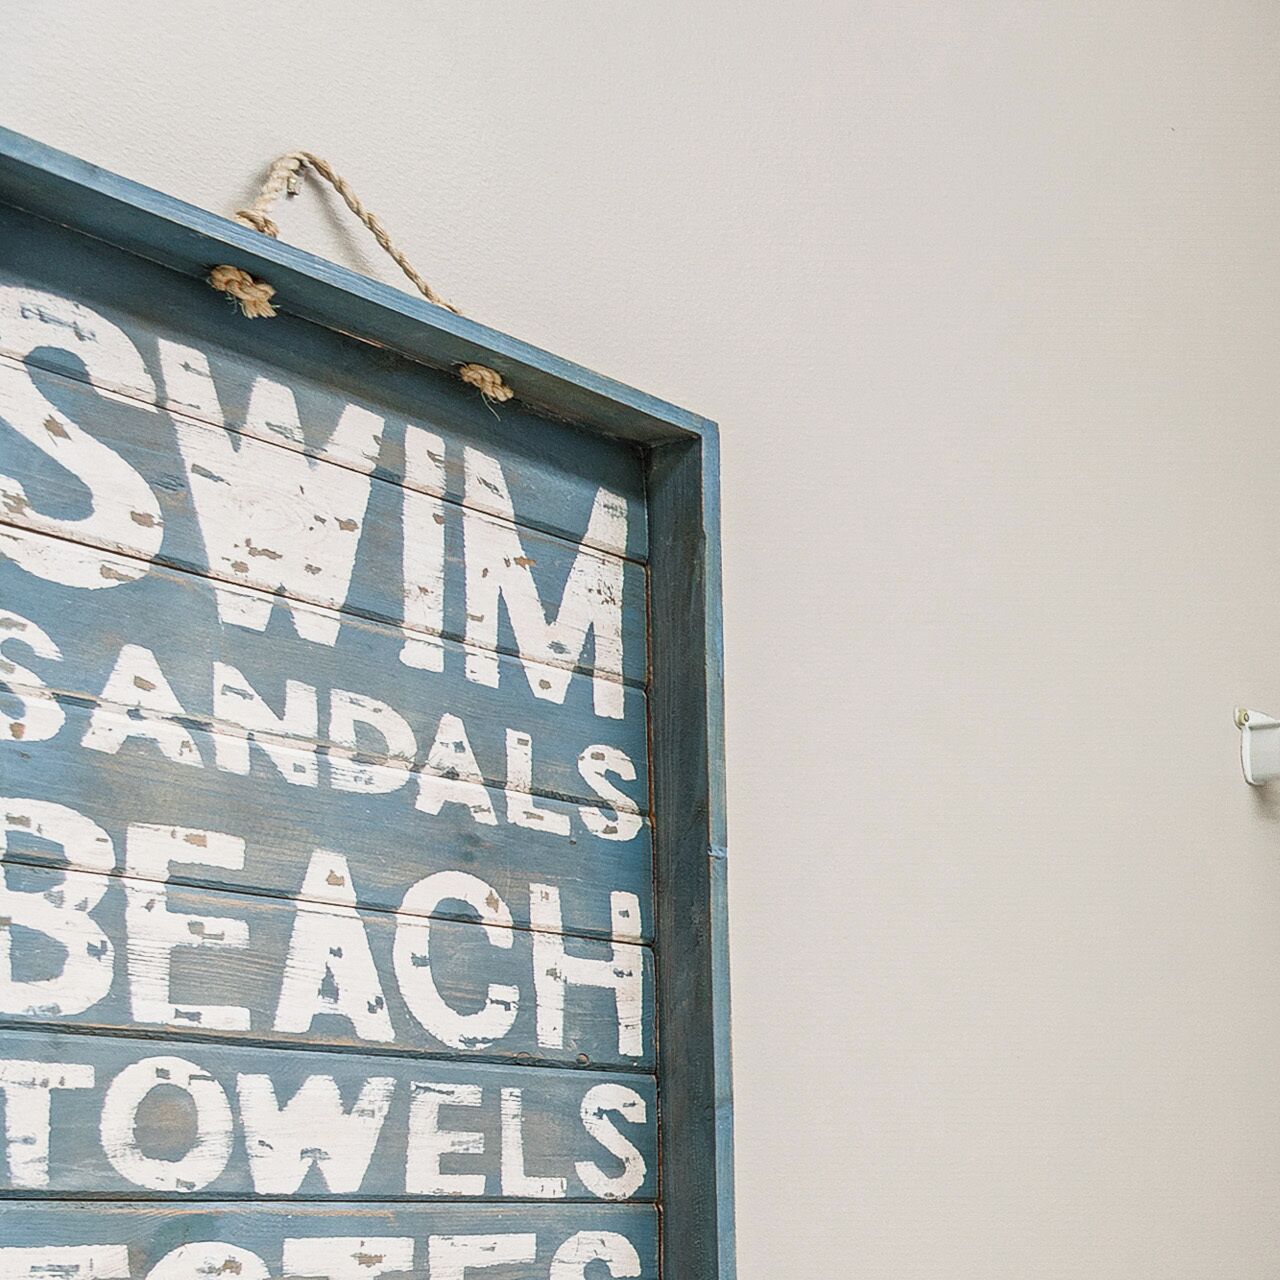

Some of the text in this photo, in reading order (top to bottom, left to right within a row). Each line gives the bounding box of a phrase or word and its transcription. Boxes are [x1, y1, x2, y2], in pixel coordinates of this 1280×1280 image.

[0, 284, 629, 721] SWIM
[0, 608, 644, 842] SANDALS
[0, 798, 645, 1058] BEACH
[0, 1056, 648, 1201] TOWELS
